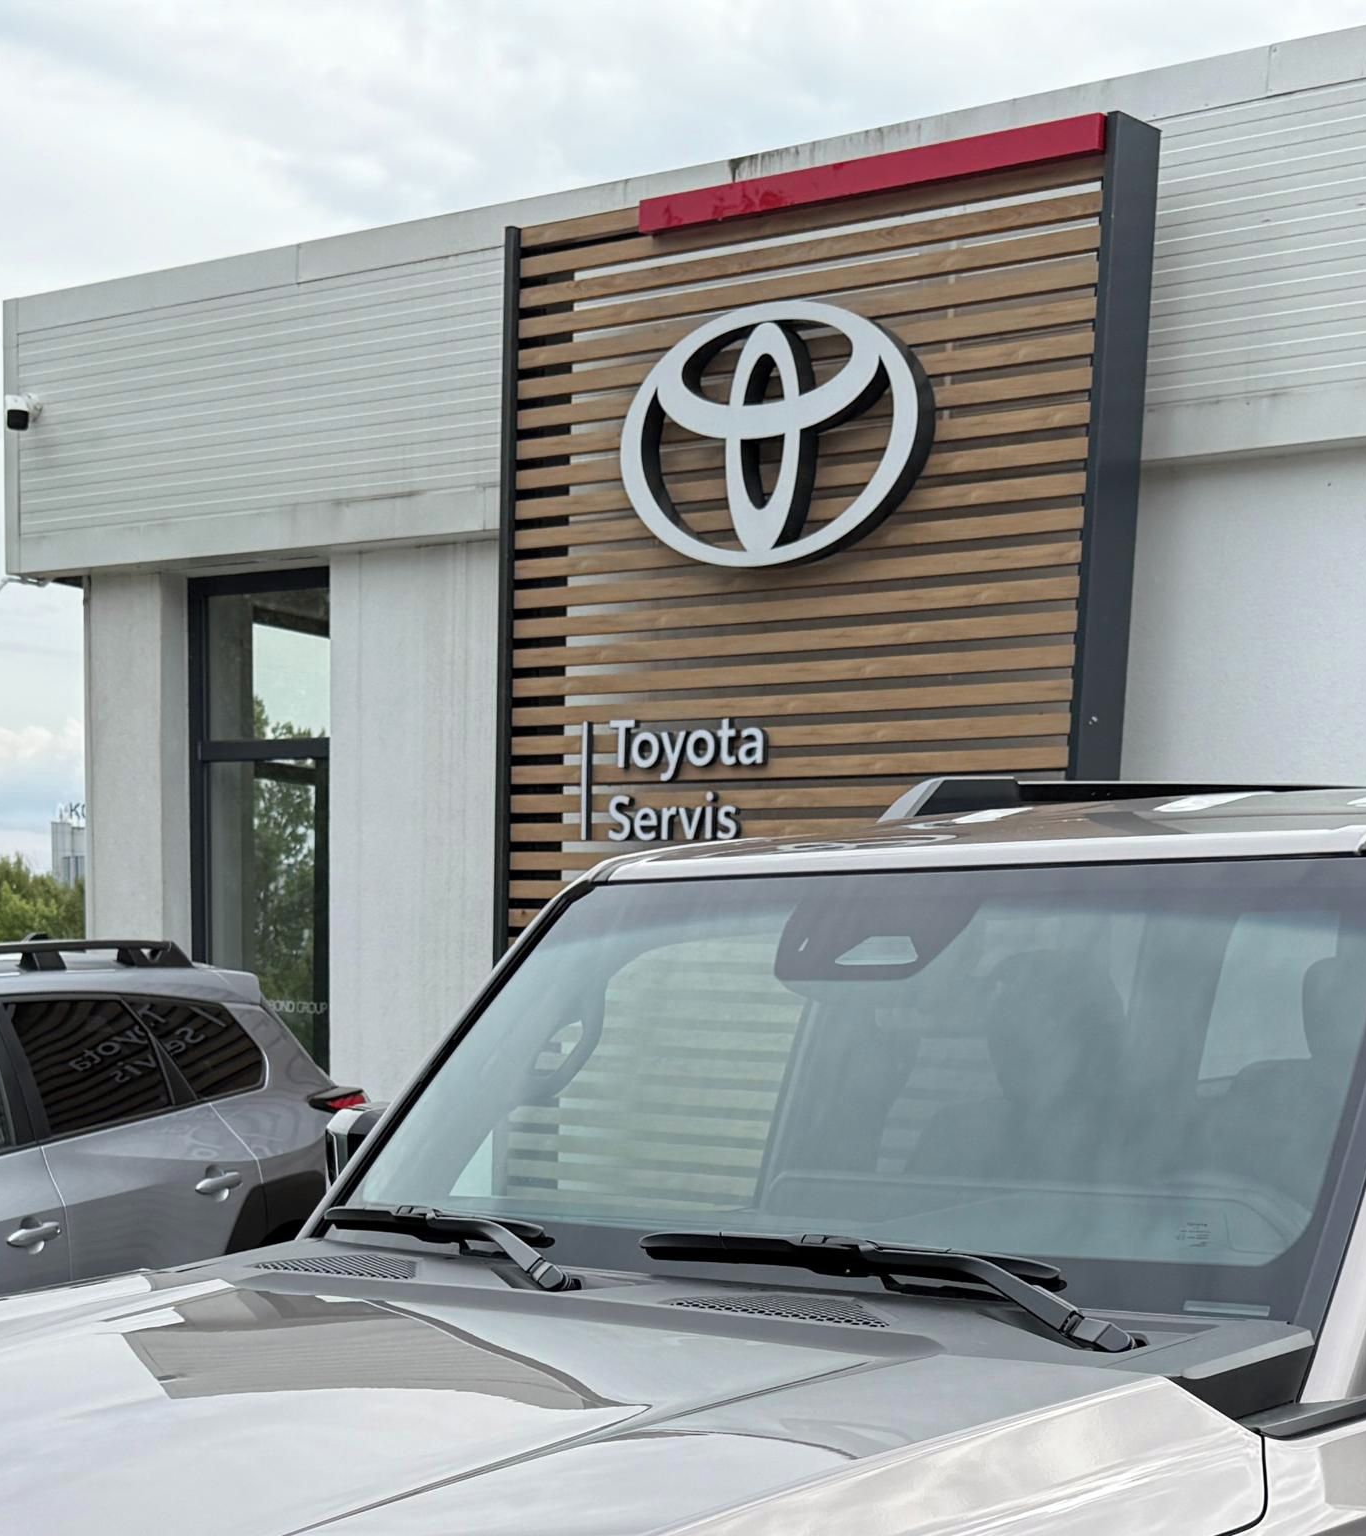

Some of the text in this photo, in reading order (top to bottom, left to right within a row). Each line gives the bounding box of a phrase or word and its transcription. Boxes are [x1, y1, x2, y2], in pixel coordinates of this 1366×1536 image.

[609, 718, 765, 781] Toyota
[608, 791, 739, 841] Servis
[296, 1001, 328, 1015] GROUP
